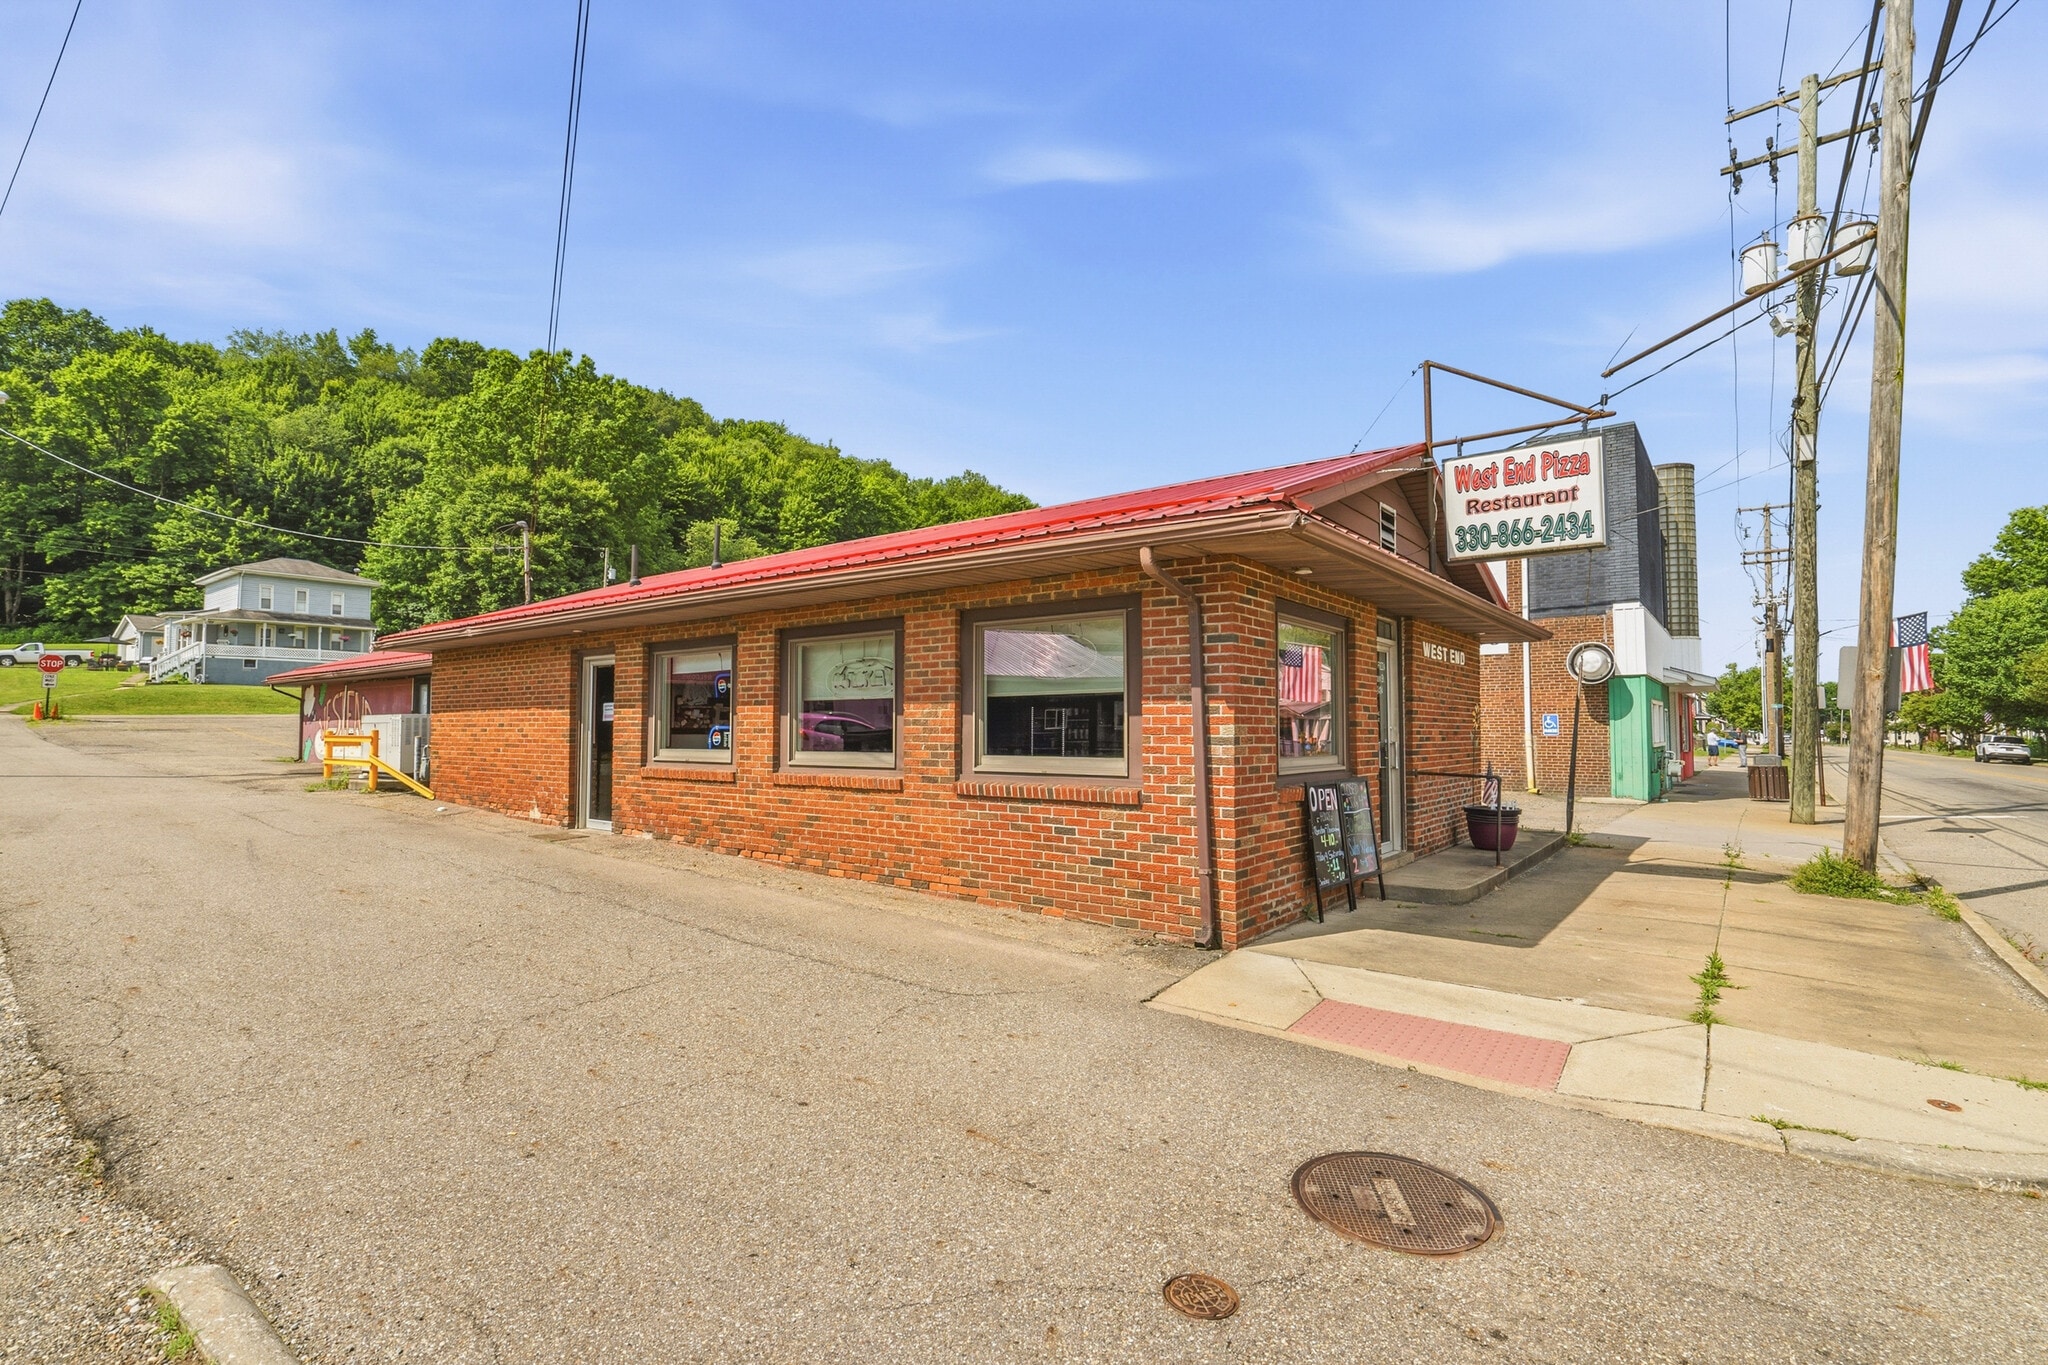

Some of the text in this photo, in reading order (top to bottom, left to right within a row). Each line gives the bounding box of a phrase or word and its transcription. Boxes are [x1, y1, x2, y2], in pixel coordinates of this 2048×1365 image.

[1454, 450, 1591, 493] West End Pizza
[1466, 485, 1580, 516] Restaurant
[1455, 510, 1594, 552] 330-866-2434
[40, 660, 63, 668] STOP
[1423, 641, 1466, 666] WEST END
[1309, 786, 1338, 812] OPEN
